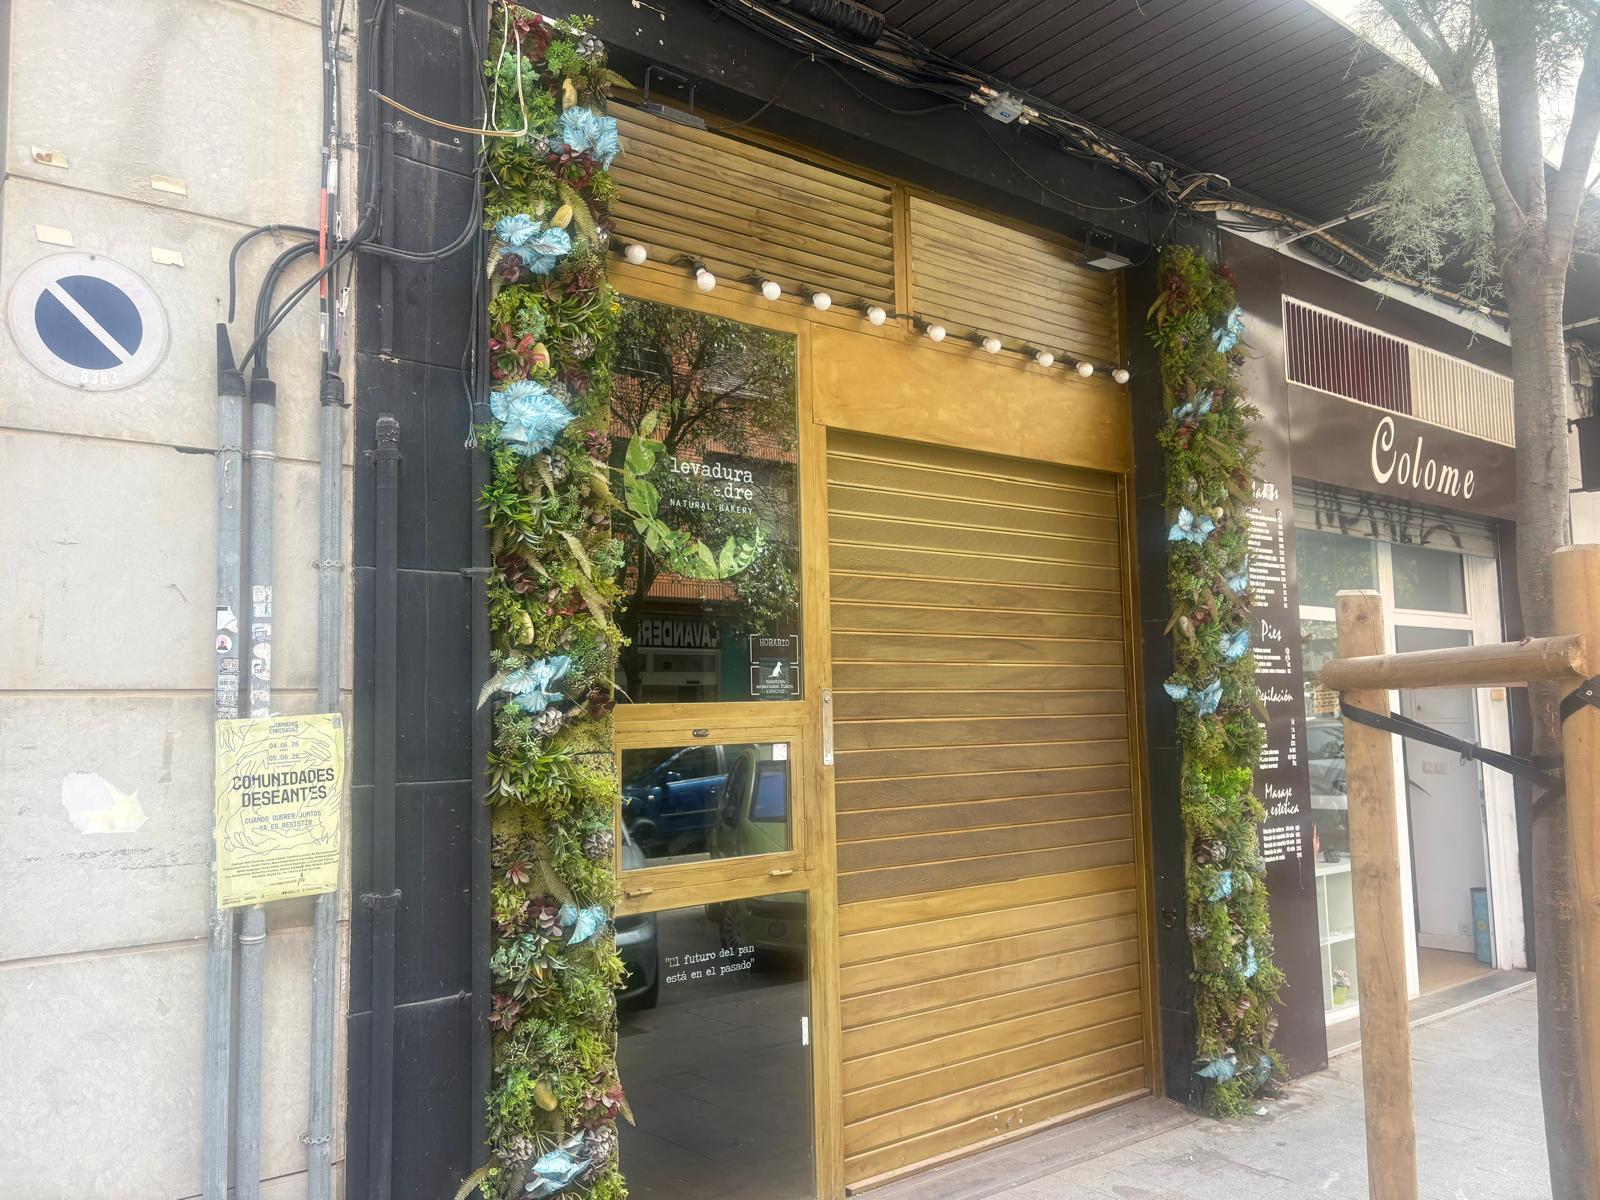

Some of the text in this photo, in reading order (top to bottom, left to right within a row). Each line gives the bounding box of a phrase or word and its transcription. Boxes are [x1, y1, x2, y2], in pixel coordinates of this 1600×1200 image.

[79, 369, 119, 384] 8383
[1371, 416, 1475, 499] Colome
[670, 456, 754, 484] levadura
[669, 498, 753, 515] NATURAL BAKERY
[1261, 619, 1282, 641] Pies
[759, 638, 790, 647] HORARIO
[232, 768, 335, 791] COMUNIDADES
[241, 785, 327, 808] DESEANTES
[244, 816, 270, 824] CUANDO
[299, 810, 322, 818] JUNTOS
[281, 819, 313, 829] RESISTIR
[684, 952, 716, 965] futuro
[719, 947, 735, 958] del
[738, 945, 755, 956] pan
[666, 957, 755, 984] está en el pasado"
